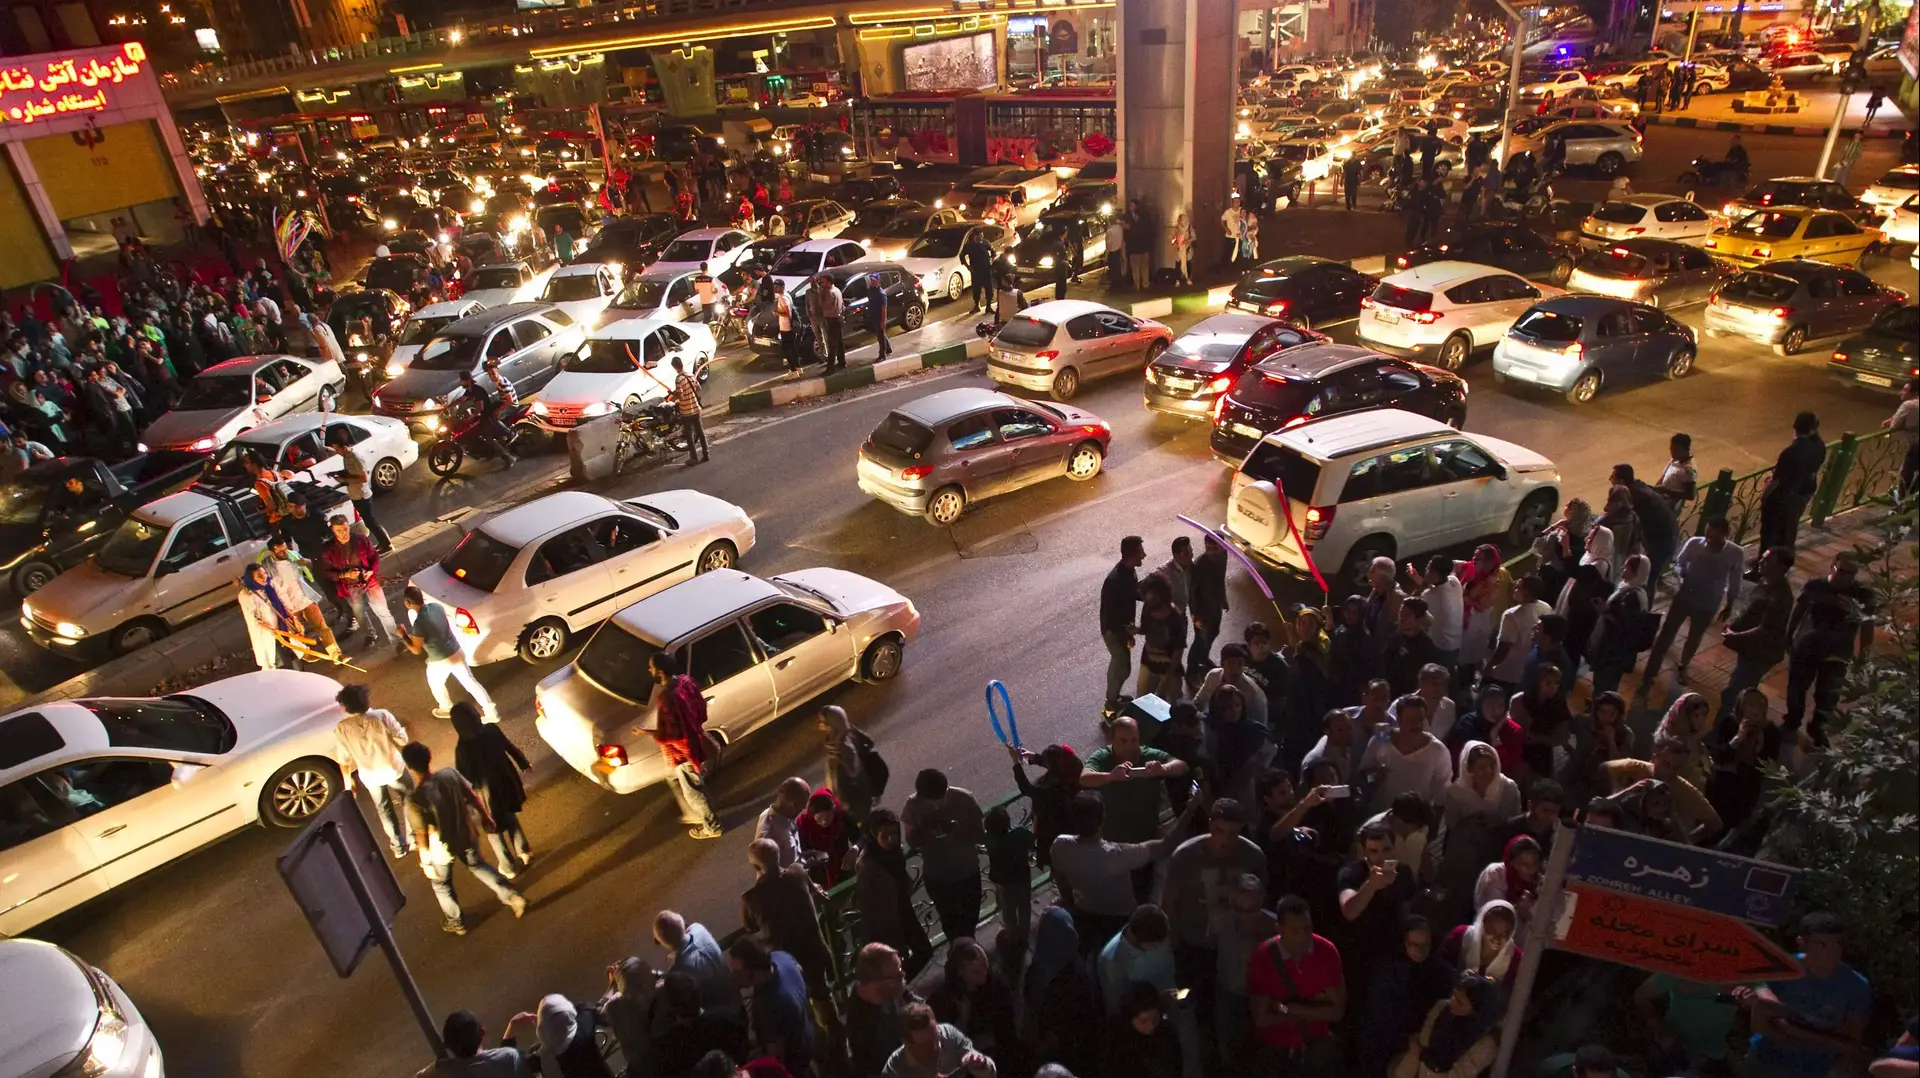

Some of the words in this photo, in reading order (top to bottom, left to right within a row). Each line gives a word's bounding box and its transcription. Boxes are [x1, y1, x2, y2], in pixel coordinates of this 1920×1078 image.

[39, 59, 78, 92] آتش
[80, 55, 140, 87] سازمان
[10, 97, 56, 123] شماره
[57, 89, 107, 111] ایستگاه
[1623, 855, 1710, 888] زهره
[1586, 874, 1642, 893] ZOHREH
[1648, 888, 1692, 905] ALLEY
[1590, 915, 1655, 938] محله
[1662, 931, 1741, 958] سرای
